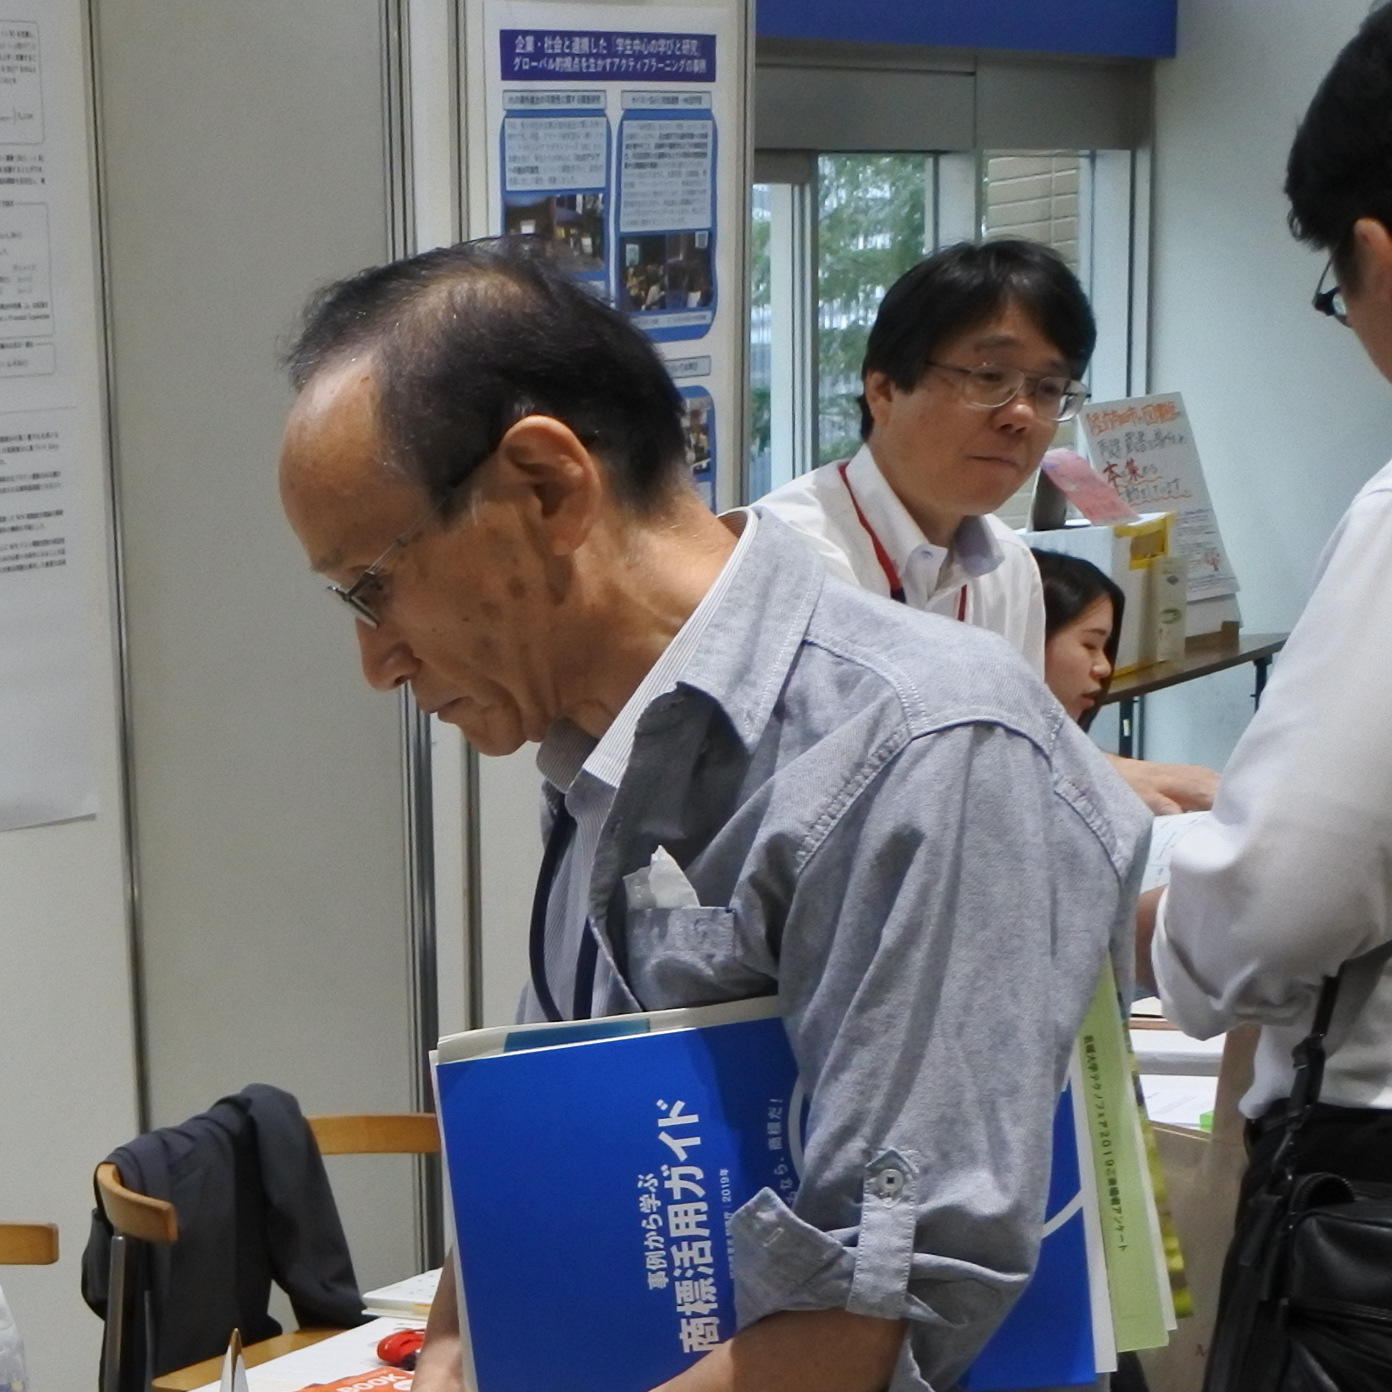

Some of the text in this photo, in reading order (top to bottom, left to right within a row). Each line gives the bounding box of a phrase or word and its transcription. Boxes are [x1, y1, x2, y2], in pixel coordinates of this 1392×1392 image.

[637, 1173, 670, 1291] 事例から学ぶ
[656, 1098, 721, 1354] 商標活用ガイド
